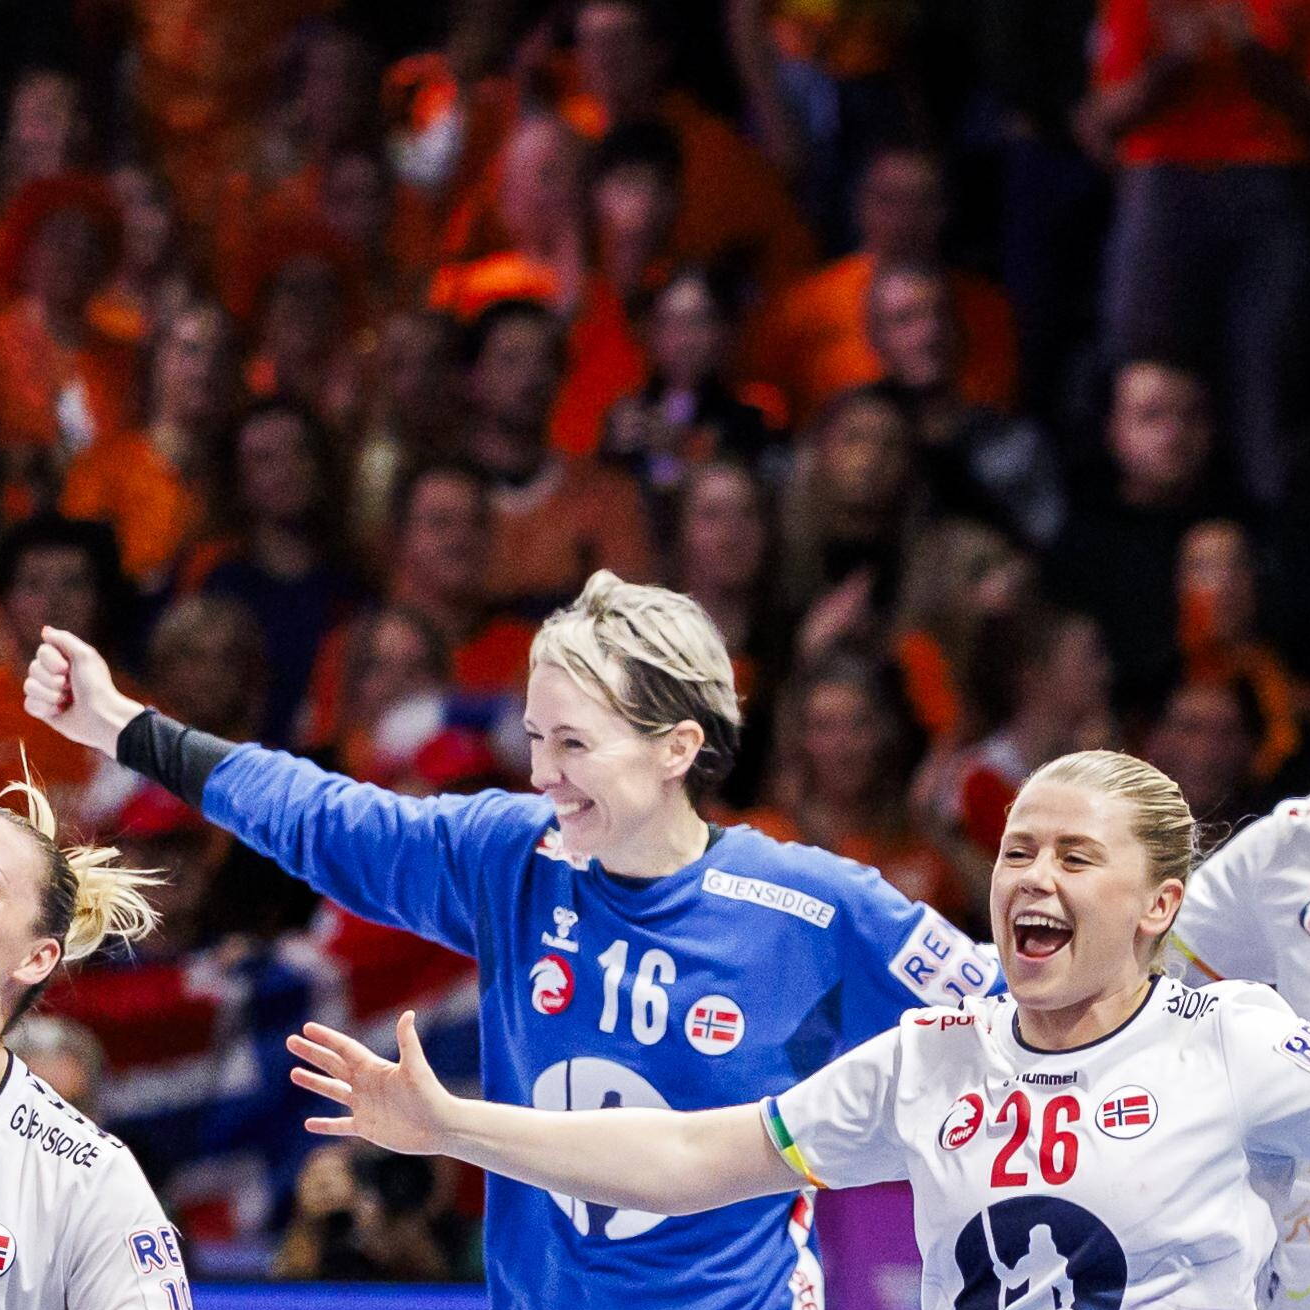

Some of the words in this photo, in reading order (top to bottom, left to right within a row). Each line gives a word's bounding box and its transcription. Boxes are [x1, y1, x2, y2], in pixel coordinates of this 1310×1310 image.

[707, 873, 831, 925] GJENSIDIGE
[597, 939, 677, 1046] 16
[10, 1103, 98, 1168] GJENSIDIGE
[950, 1126, 974, 1145] NHF
[990, 1090, 1081, 1188] 26
